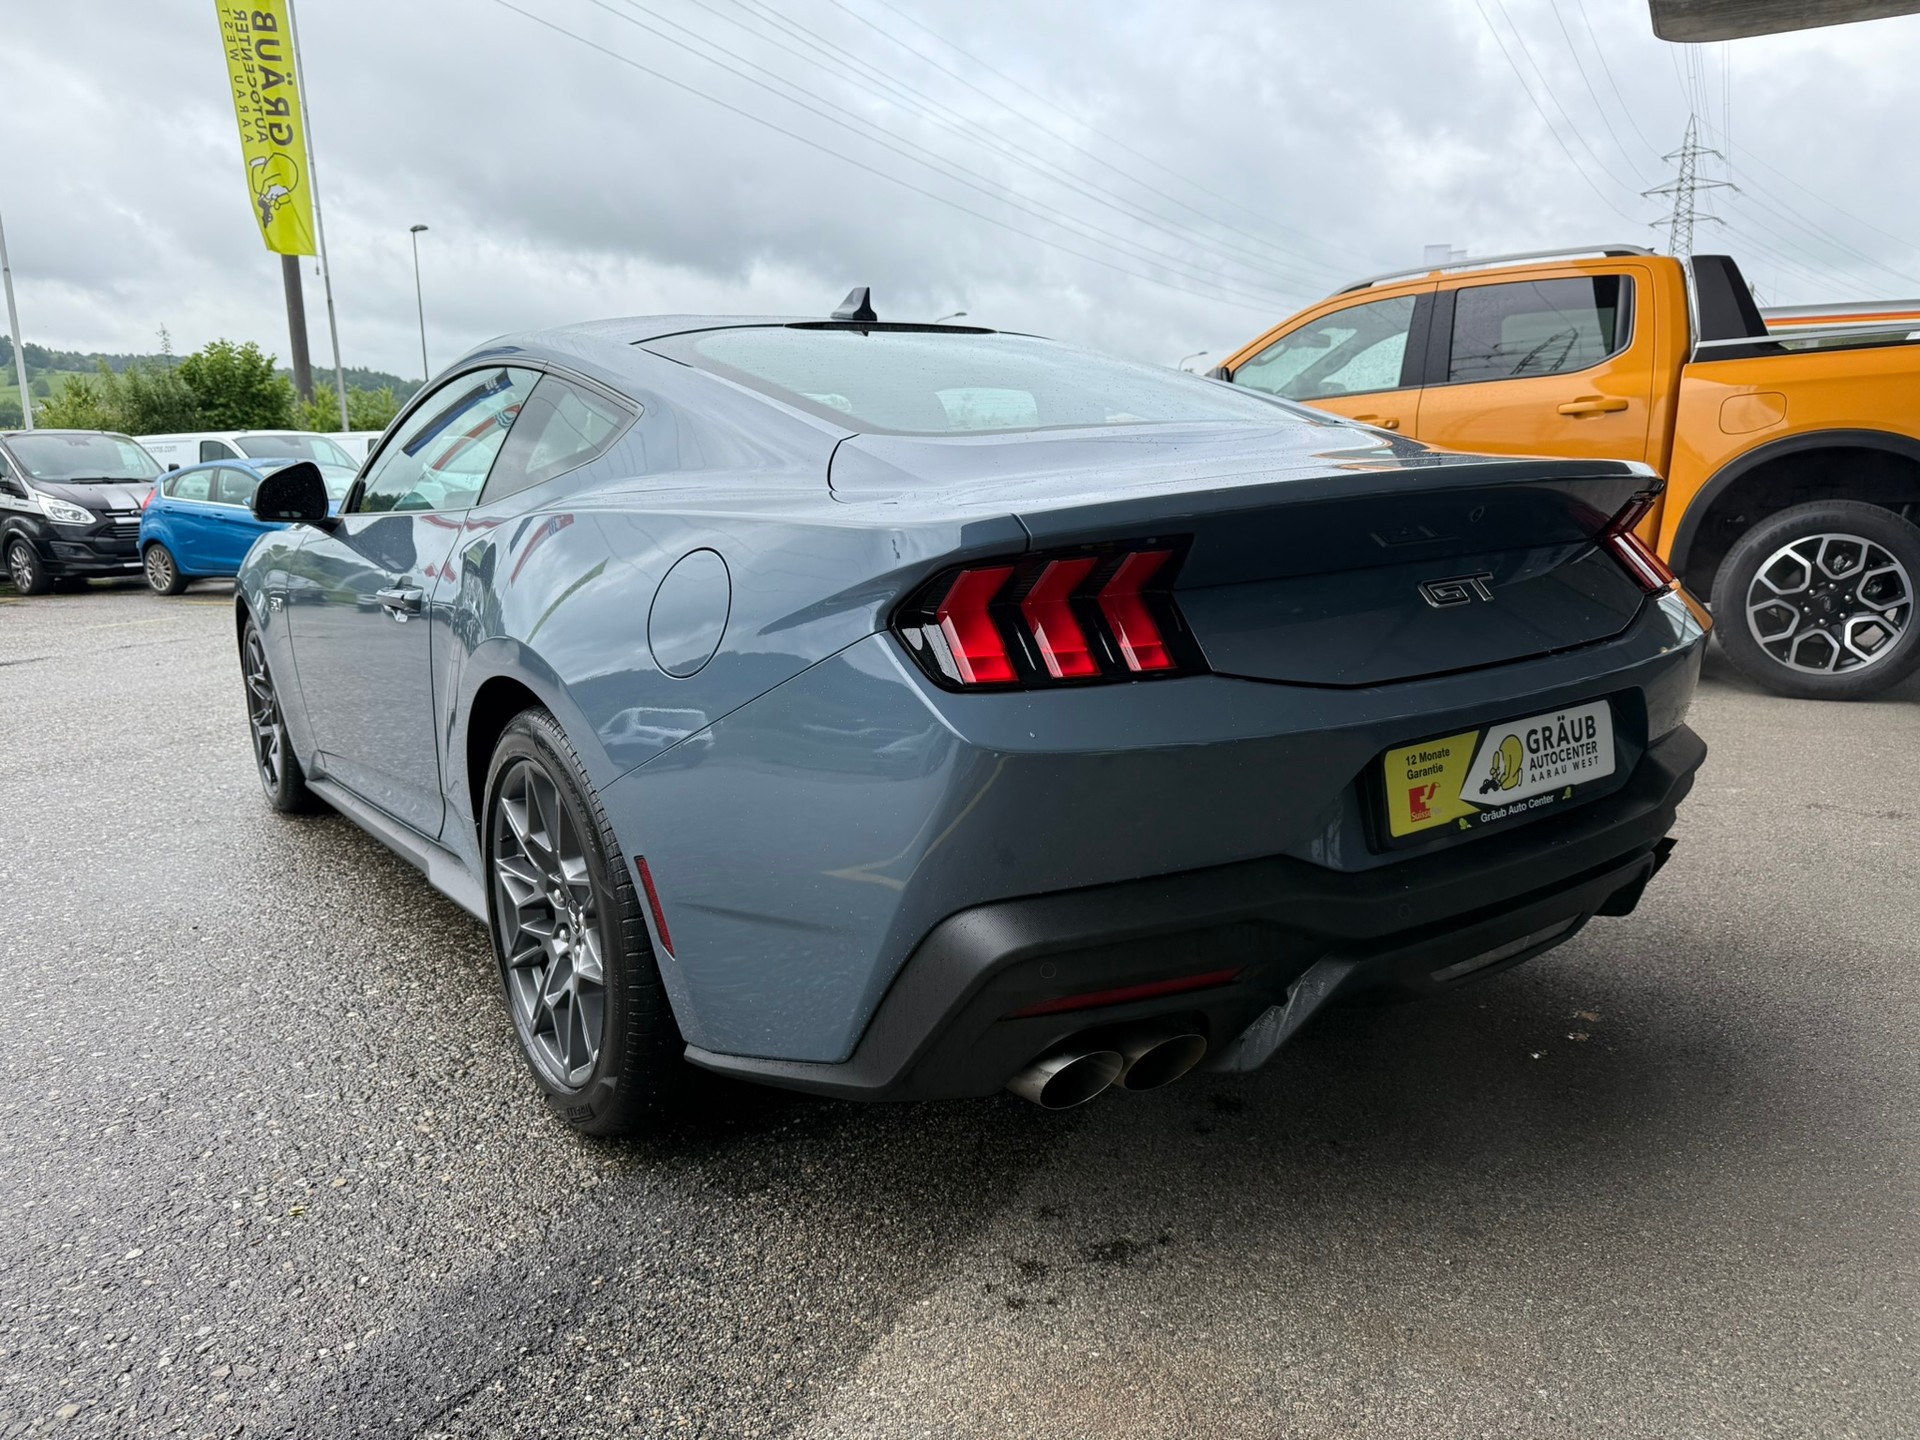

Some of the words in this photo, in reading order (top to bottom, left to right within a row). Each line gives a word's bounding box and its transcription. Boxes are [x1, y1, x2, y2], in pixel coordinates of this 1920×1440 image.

[1417, 571, 1495, 609] GT
[1526, 714, 1597, 755] GRÄUB
[1405, 755, 1417, 766] 12
[1419, 747, 1451, 762] Monate
[1529, 741, 1598, 771] AUTOCENTER
[1530, 765, 1567, 783] AARAU
[1572, 755, 1599, 771] WEST
[1406, 763, 1444, 780] Garantie
[1480, 808, 1506, 823] Gräub
[1508, 801, 1527, 815] Auto
[1528, 794, 1554, 809] Center
